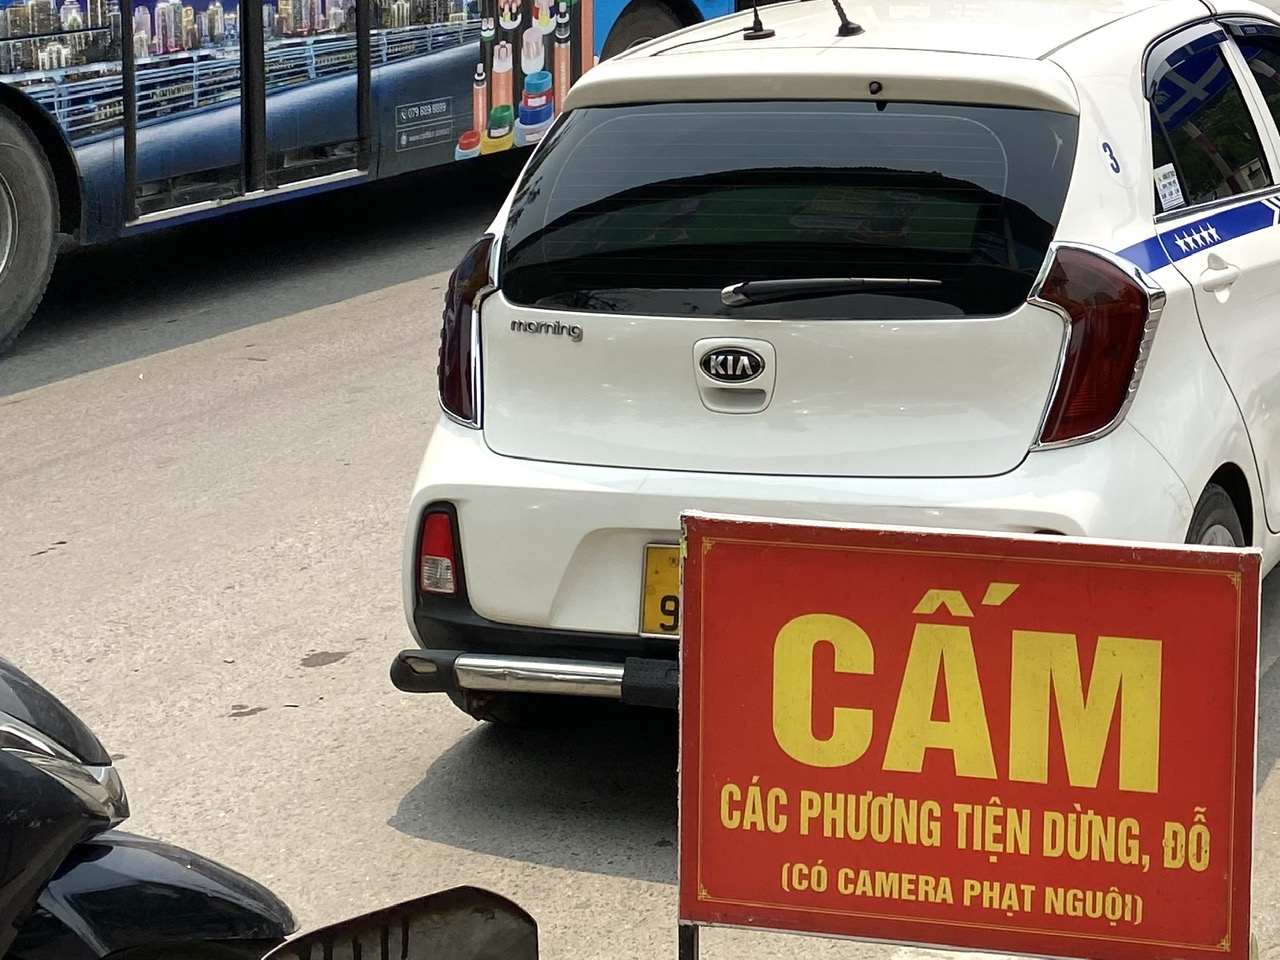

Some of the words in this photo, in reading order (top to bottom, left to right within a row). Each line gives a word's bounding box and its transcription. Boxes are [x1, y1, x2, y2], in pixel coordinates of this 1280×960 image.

[1102, 142, 1121, 173] 3
[511, 318, 584, 343] morning
[709, 354, 755, 375] KIA
[772, 582, 1162, 794] CẤM
[720, 776, 788, 835] CÁC
[800, 791, 942, 847] PHƯƠNG
[953, 795, 1032, 864] TIỆN
[1042, 802, 1150, 873] DỪNG,
[1160, 806, 1212, 872] ĐỖ
[781, 859, 828, 893] (CÓ
[837, 867, 954, 904] CAMERA
[963, 884, 1036, 918] PHẠT
[1043, 887, 1144, 926] NGUỘI)
